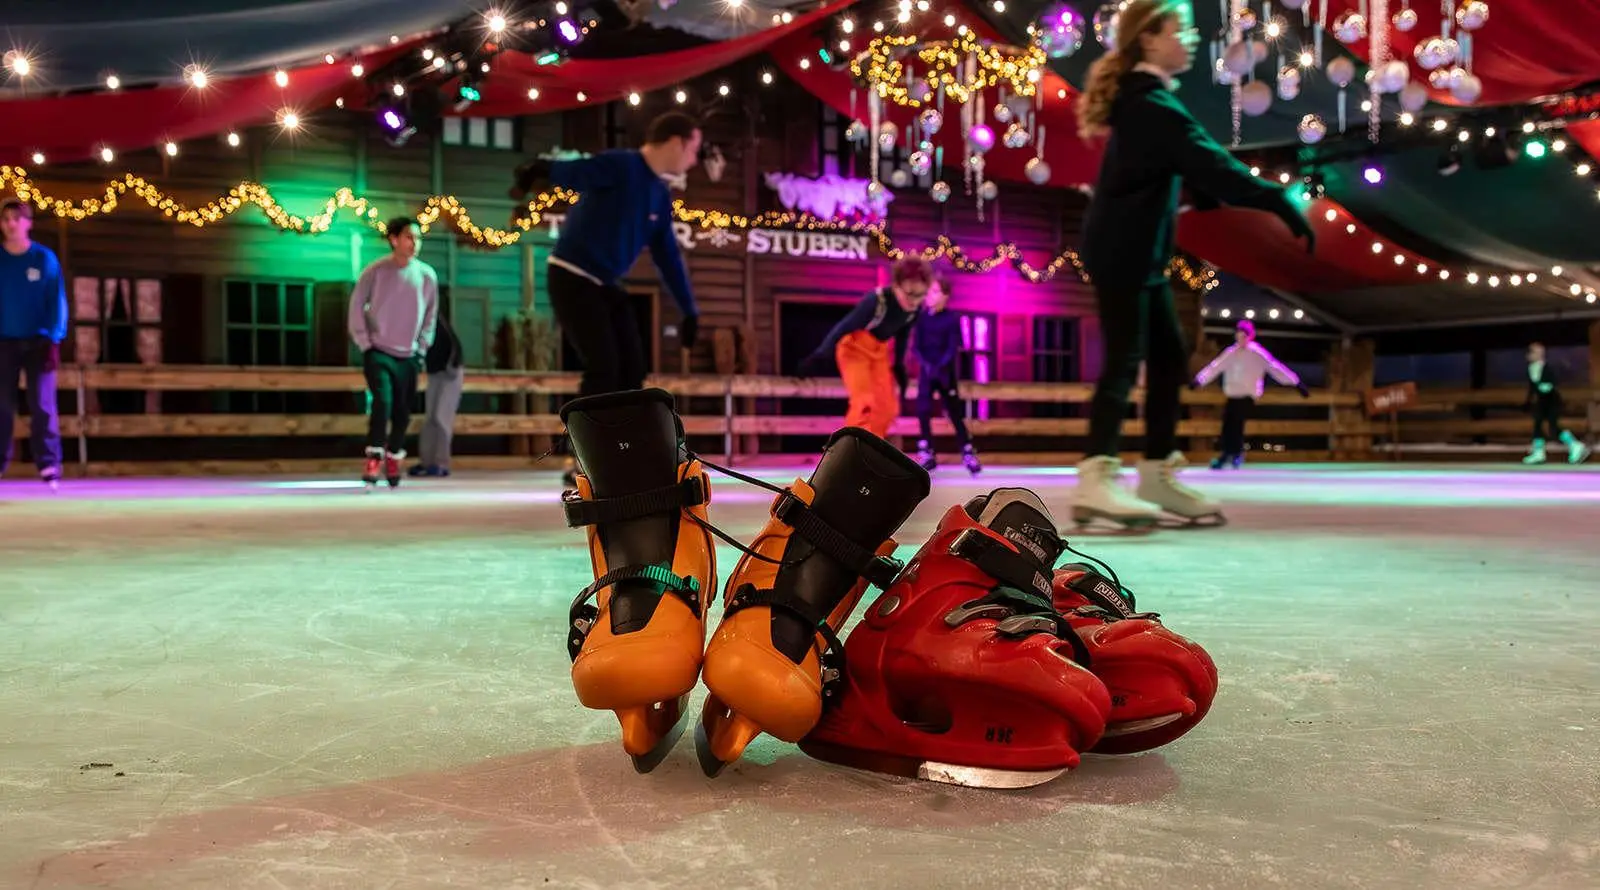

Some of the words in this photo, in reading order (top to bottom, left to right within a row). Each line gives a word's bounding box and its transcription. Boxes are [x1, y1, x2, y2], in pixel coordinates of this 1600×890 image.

[746, 228, 869, 260] STUBEN
[618, 442, 629, 450] 39
[859, 486, 870, 495] 39
